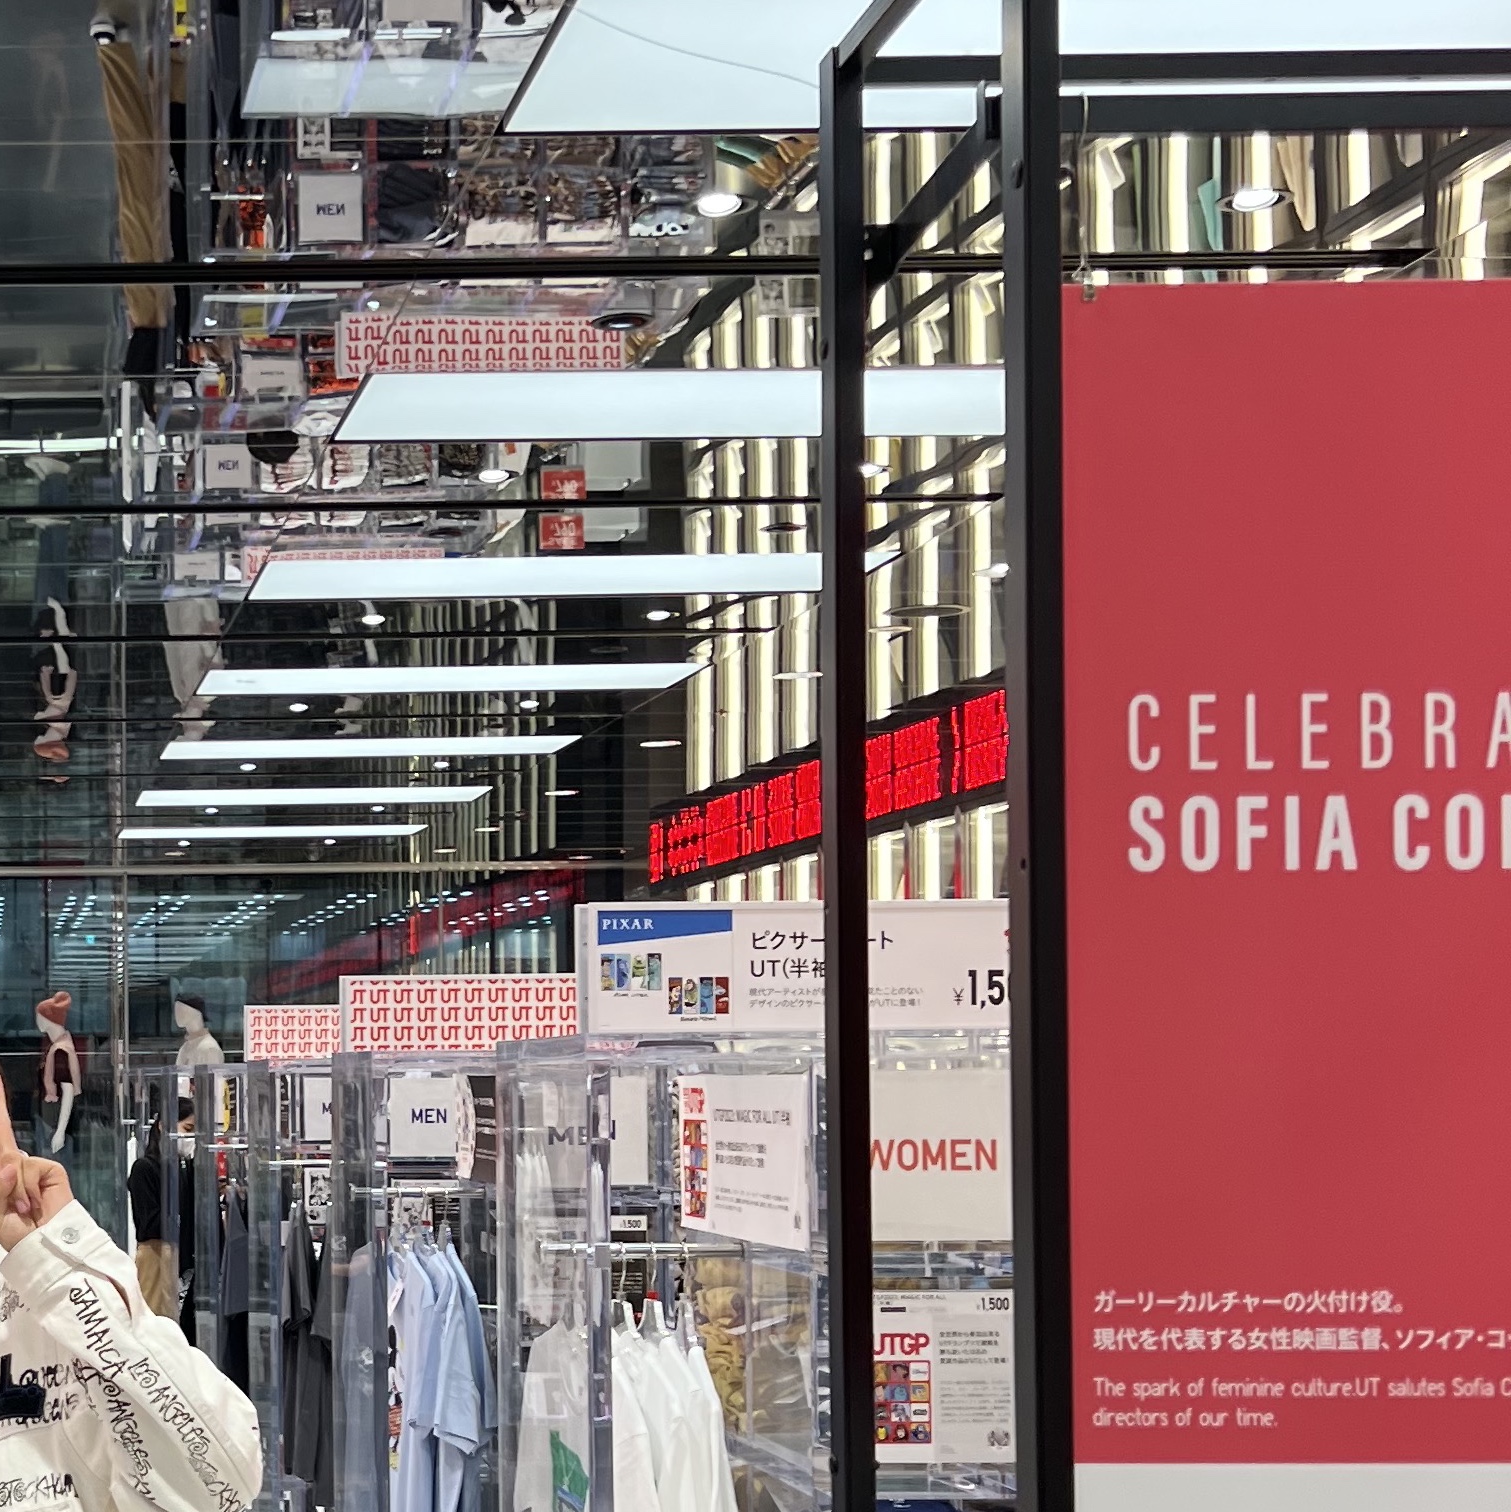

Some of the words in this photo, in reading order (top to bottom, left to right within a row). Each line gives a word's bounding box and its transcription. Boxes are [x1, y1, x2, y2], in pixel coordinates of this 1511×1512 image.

[1127, 691, 1511, 771] CELEBRA
[1127, 794, 1358, 872] SOFIA
[1393, 793, 1511, 871] CO
[602, 918, 654, 930] PIXAR
[370, 989, 389, 1004] UT
[394, 989, 412, 1004] UT
[417, 989, 436, 1004] UT
[440, 988, 460, 1003] UT
[464, 988, 483, 1003] UT
[487, 988, 507, 1003] UT
[512, 987, 530, 1003] UT
[535, 987, 554, 1002] UT
[370, 1008, 389, 1023] UT
[394, 1007, 412, 1023] UT
[417, 1007, 436, 1022] UT
[441, 1007, 459, 1022] UT
[465, 1007, 484, 1022] UT
[488, 1006, 507, 1021] UT
[512, 1006, 532, 1021] UT
[536, 1006, 554, 1021] UT
[411, 1108, 447, 1124] MEN
[871, 1139, 997, 1171] WOMEN
[1094, 1290, 1404, 1314] ガーリーカルチャーの火付け役。
[1093, 1377, 1126, 1398] The
[1132, 1377, 1180, 1401] spark
[1187, 1377, 1205, 1398] of
[1211, 1377, 1285, 1398] feminine
[1387, 1377, 1446, 1398] salutes
[1452, 1377, 1494, 1398] Sofia
[1092, 1407, 1168, 1428] directors
[1175, 1407, 1193, 1428] of
[1199, 1411, 1228, 1428] our
[1236, 1407, 1279, 1428] time.
